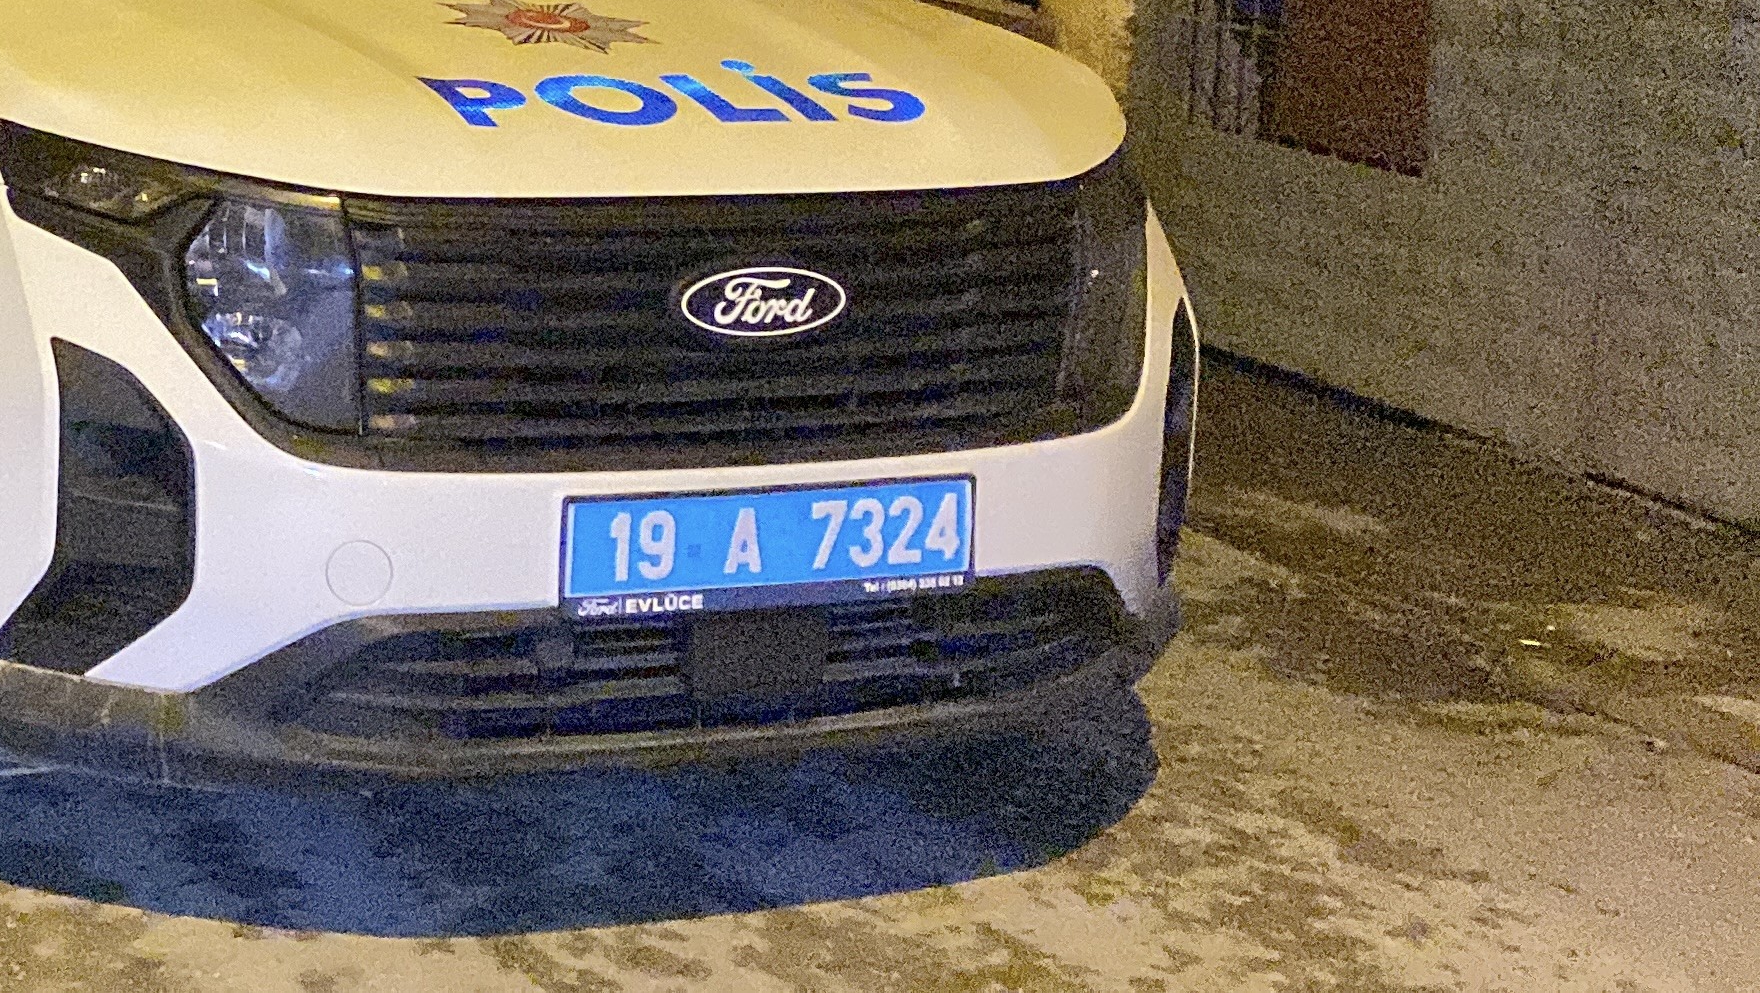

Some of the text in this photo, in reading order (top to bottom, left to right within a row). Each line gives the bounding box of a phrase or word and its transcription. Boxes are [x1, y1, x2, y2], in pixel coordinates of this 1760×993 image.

[412, 59, 926, 127] POLİS
[713, 277, 815, 324] Ford
[609, 493, 961, 582] 19 A 7324
